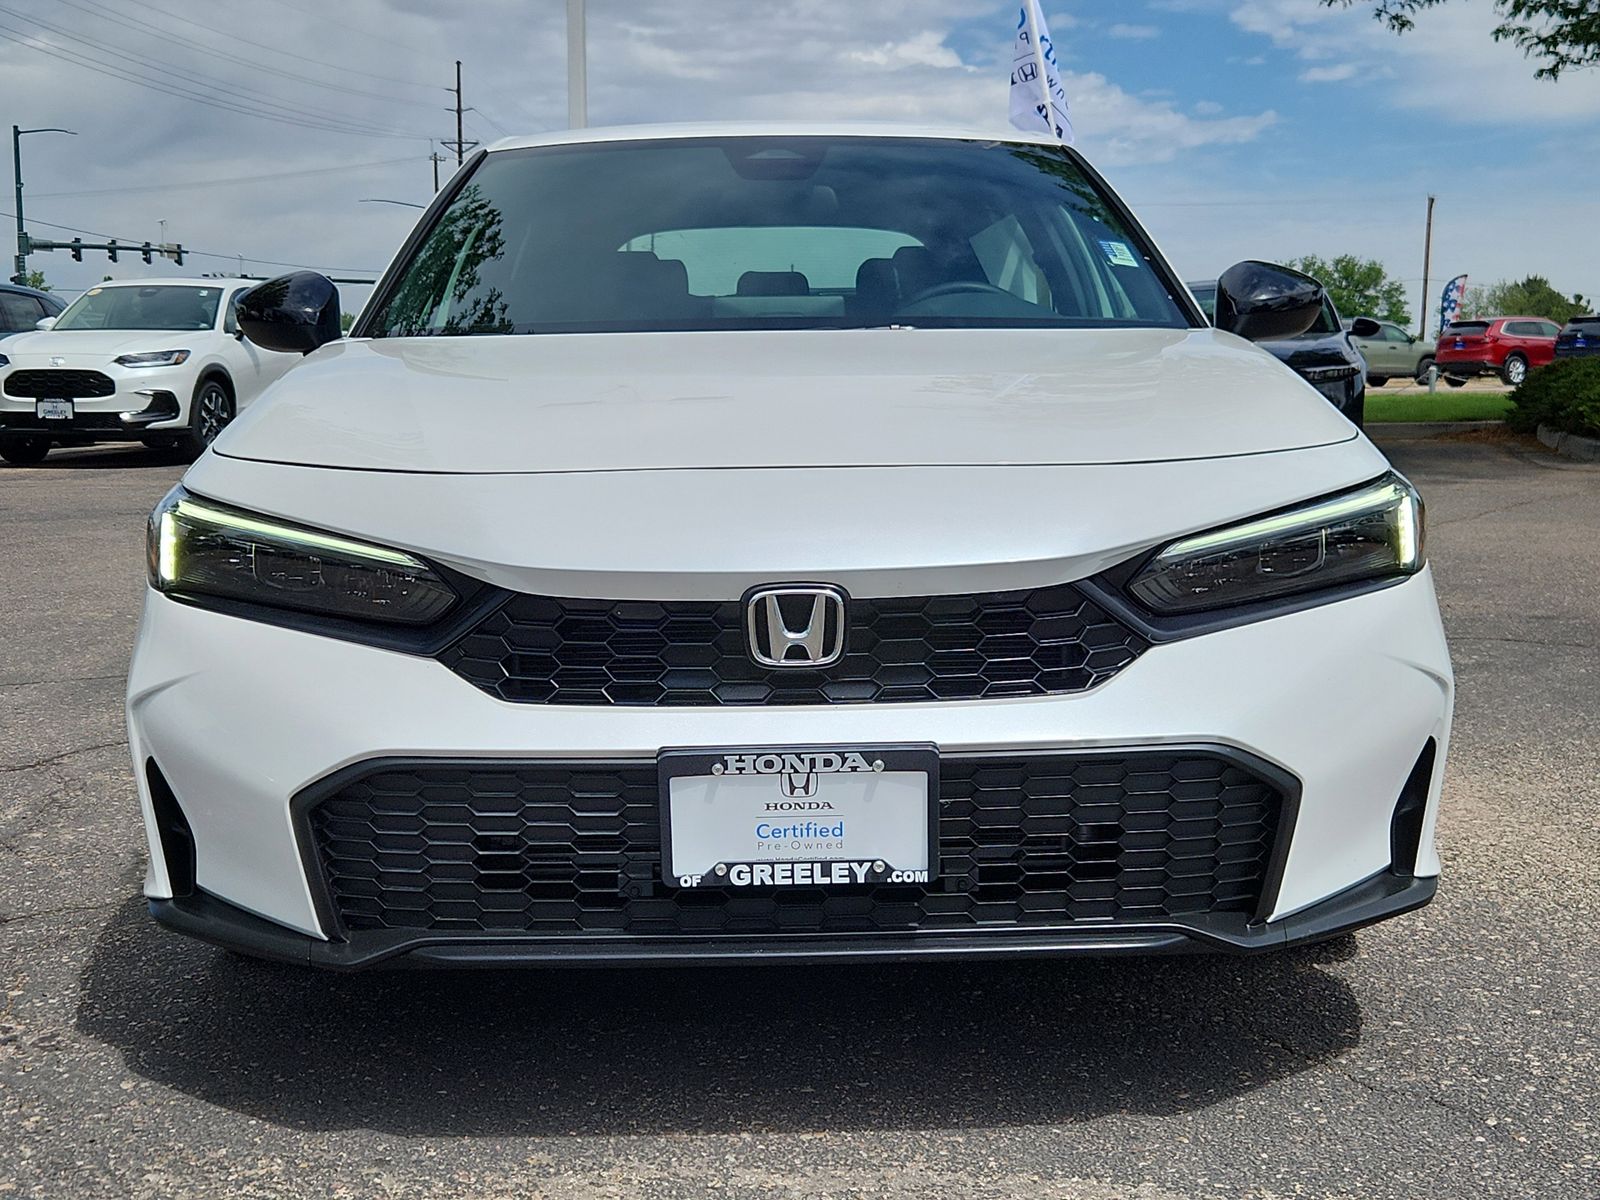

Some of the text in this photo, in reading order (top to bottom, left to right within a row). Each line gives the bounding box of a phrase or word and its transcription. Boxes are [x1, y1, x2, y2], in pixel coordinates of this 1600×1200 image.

[723, 753, 873, 774] HONDA
[764, 801, 835, 811] HONDA
[756, 821, 843, 839] Certified
[757, 840, 843, 850] Pre-Owned
[680, 862, 929, 887] OF GREELEY .COM
